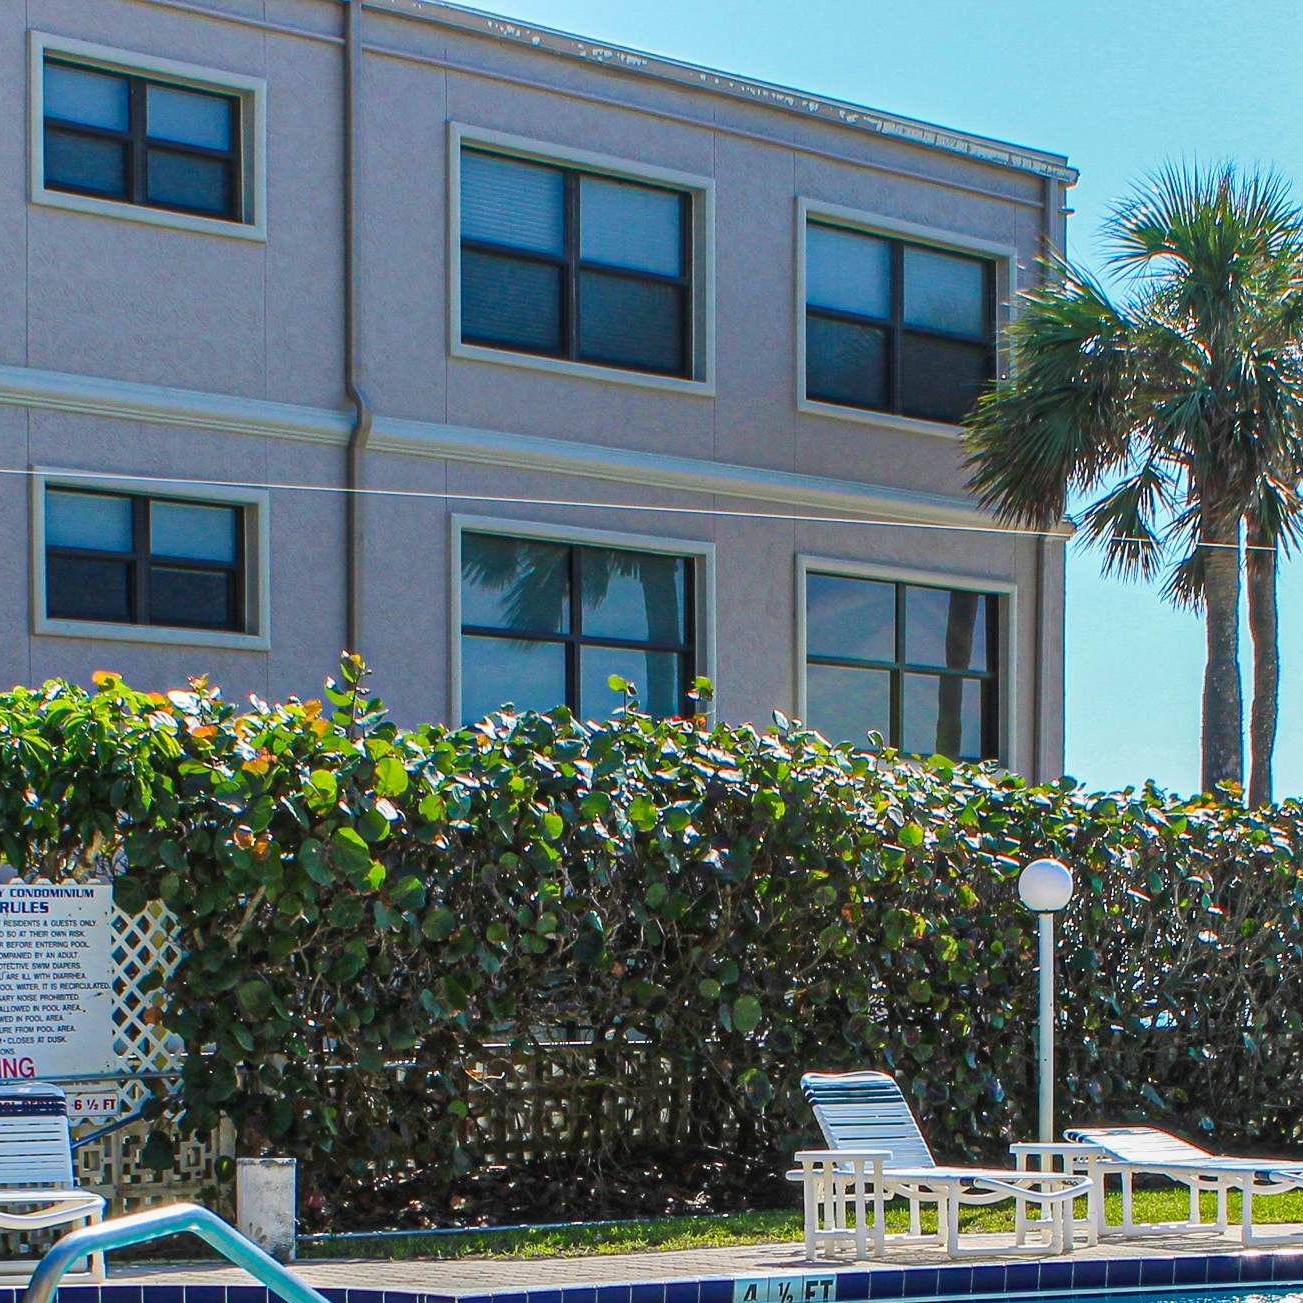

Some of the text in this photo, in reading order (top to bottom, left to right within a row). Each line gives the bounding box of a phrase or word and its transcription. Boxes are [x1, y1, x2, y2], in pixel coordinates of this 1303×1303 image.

[10, 889, 94, 897] CONDOMINIUM
[0, 902, 48, 913] RULES
[74, 1099, 82, 1110] 6
[103, 1098, 116, 1110] FT
[805, 1280, 834, 1303] FT
